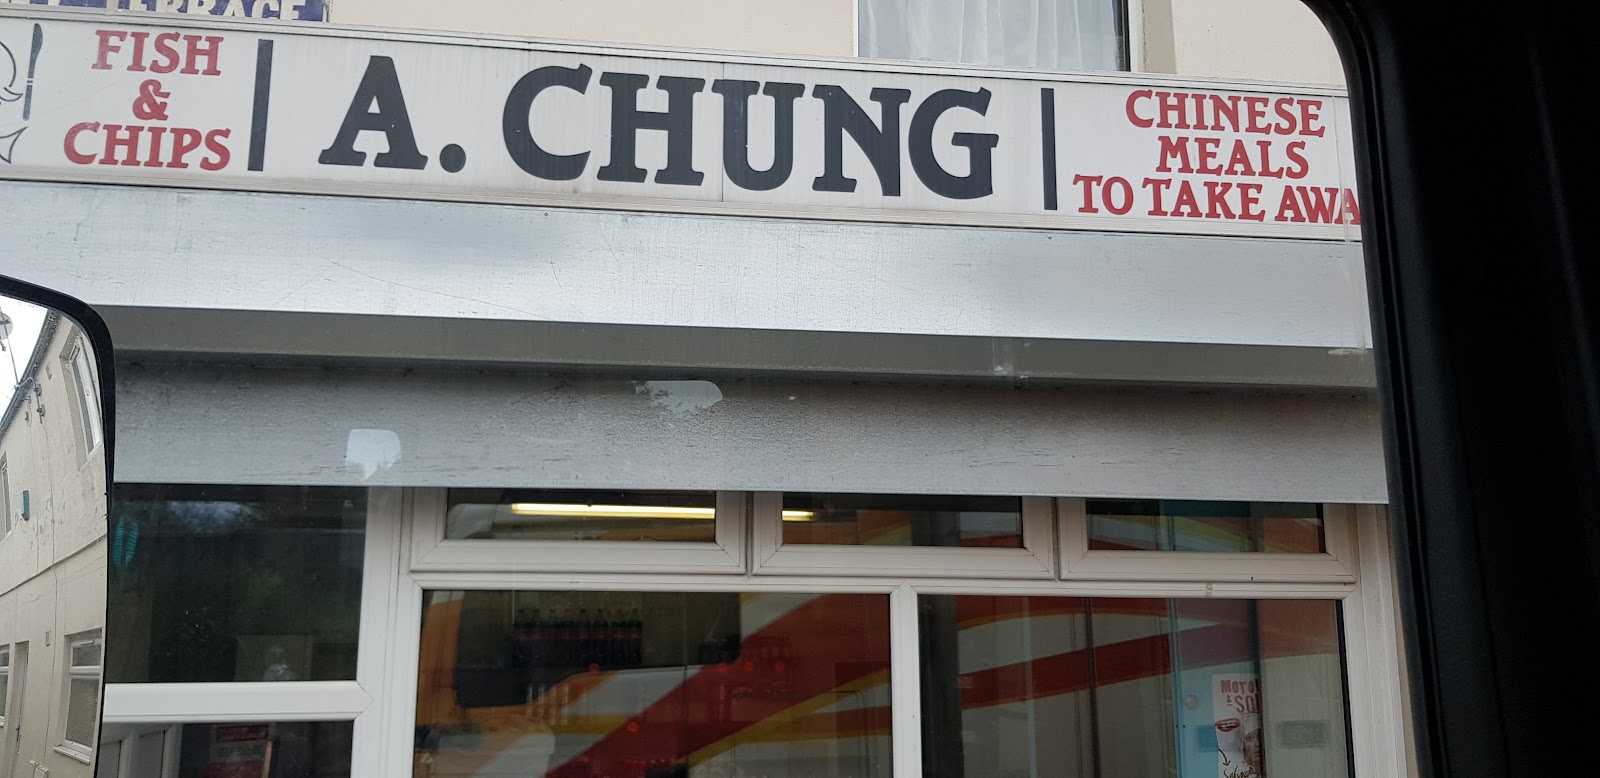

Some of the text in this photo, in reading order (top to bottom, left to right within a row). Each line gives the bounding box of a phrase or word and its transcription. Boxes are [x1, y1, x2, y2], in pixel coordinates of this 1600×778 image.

[92, 29, 224, 76] FISH
[132, 79, 170, 121] &
[1126, 89, 1326, 138] CHINESE
[63, 121, 231, 171] CHIPS
[319, 56, 1000, 199] A. CHUNG
[1156, 135, 1310, 180] MEALS
[1073, 174, 1134, 215] TO
[1142, 177, 1266, 222] TAKE
